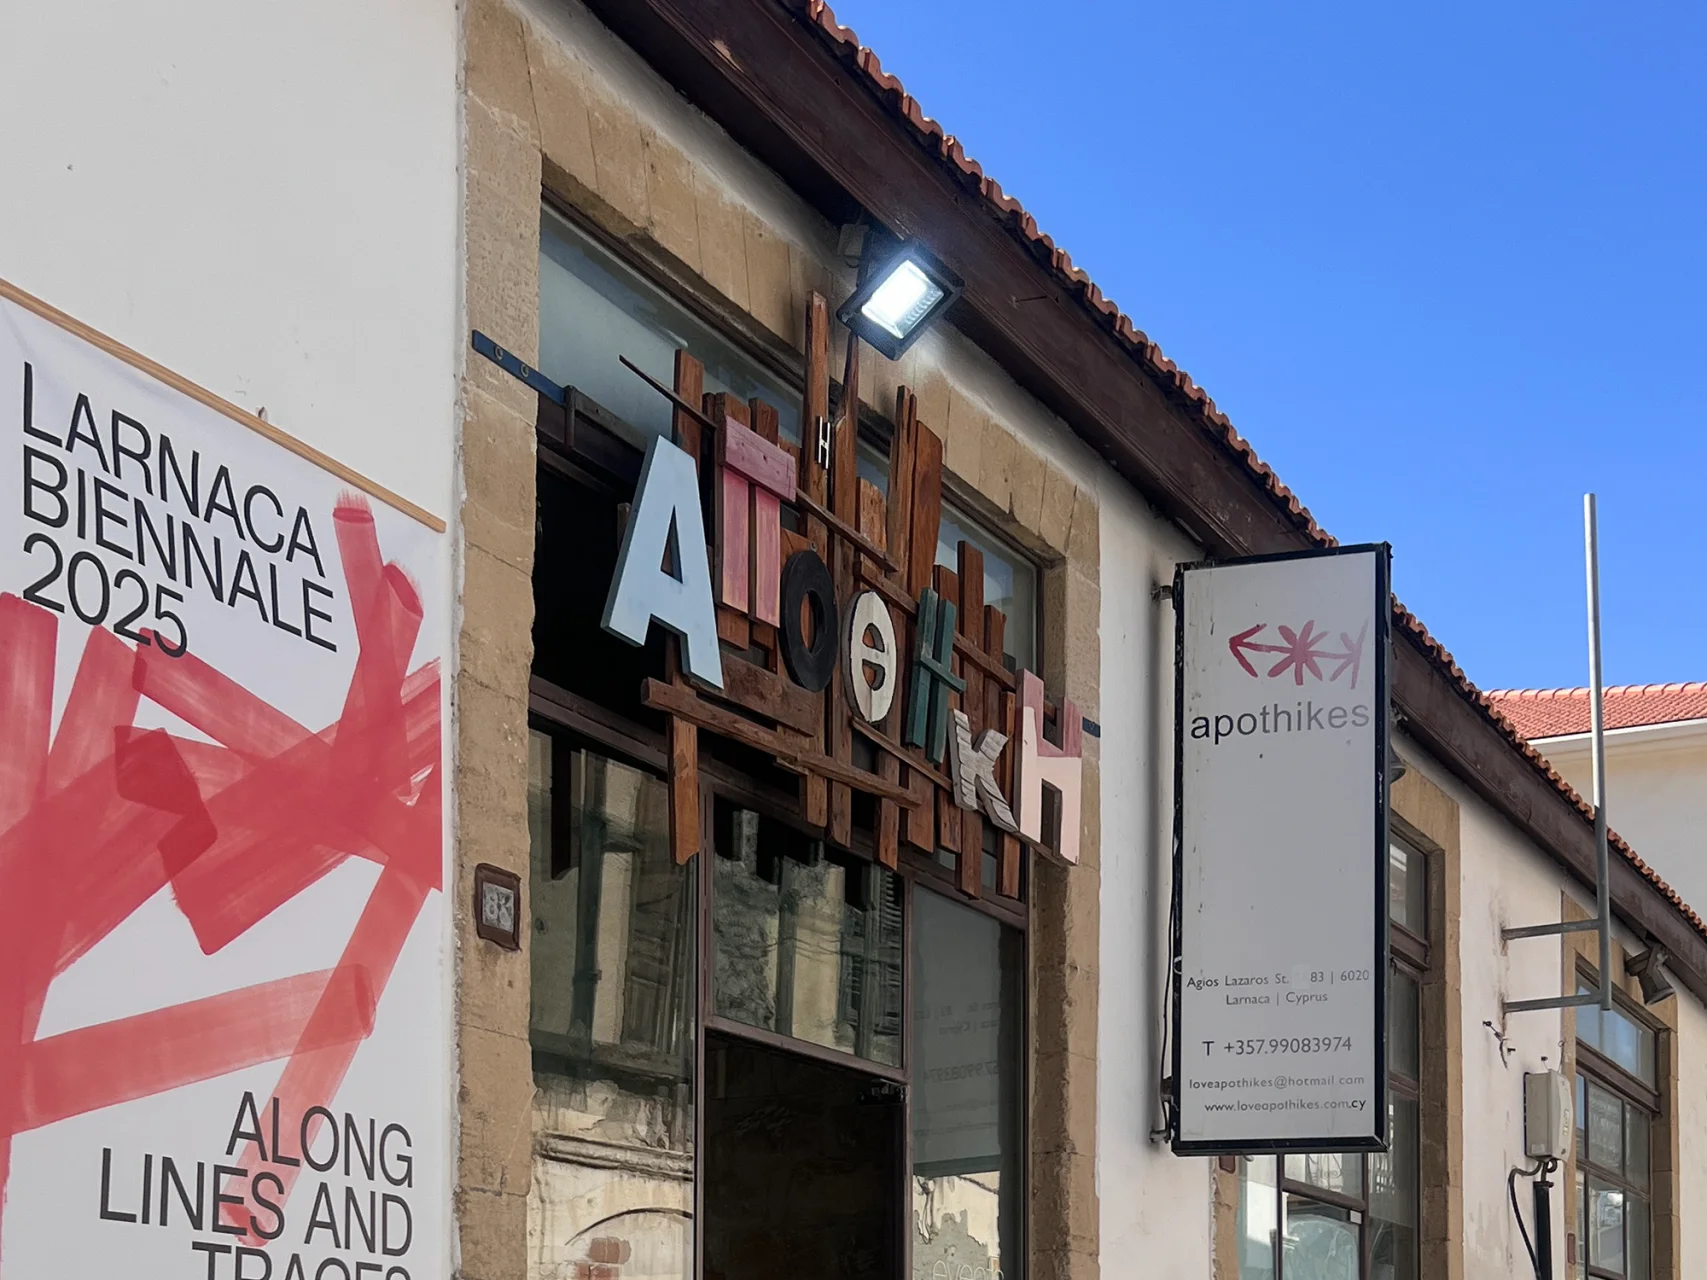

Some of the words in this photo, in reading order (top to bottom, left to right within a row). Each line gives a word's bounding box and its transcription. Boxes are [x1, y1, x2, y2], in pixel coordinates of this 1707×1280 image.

[23, 361, 326, 578] LARNACA
[23, 444, 337, 652] BIENNALE
[22, 532, 188, 658] 2025
[1190, 701, 1370, 745] apothikes
[1186, 976, 1219, 991] Agios
[1224, 975, 1269, 986] Lazaros
[1274, 973, 1289, 984] St.
[1310, 971, 1324, 983] 83
[1340, 970, 1370, 982] 6020
[1226, 995, 1270, 1005] Larnaca
[1285, 991, 1328, 1005] Cyprus
[1202, 1041, 1215, 1056] T
[1223, 1036, 1352, 1055] +357.99083974
[1189, 1075, 1365, 1090] loveapothikes@hotmail.com
[1204, 1099, 1367, 1113] www.loveapothikes.com.cy
[225, 1090, 413, 1188] ALONG
[99, 1147, 285, 1240] LINES
[304, 1182, 413, 1257] AND
